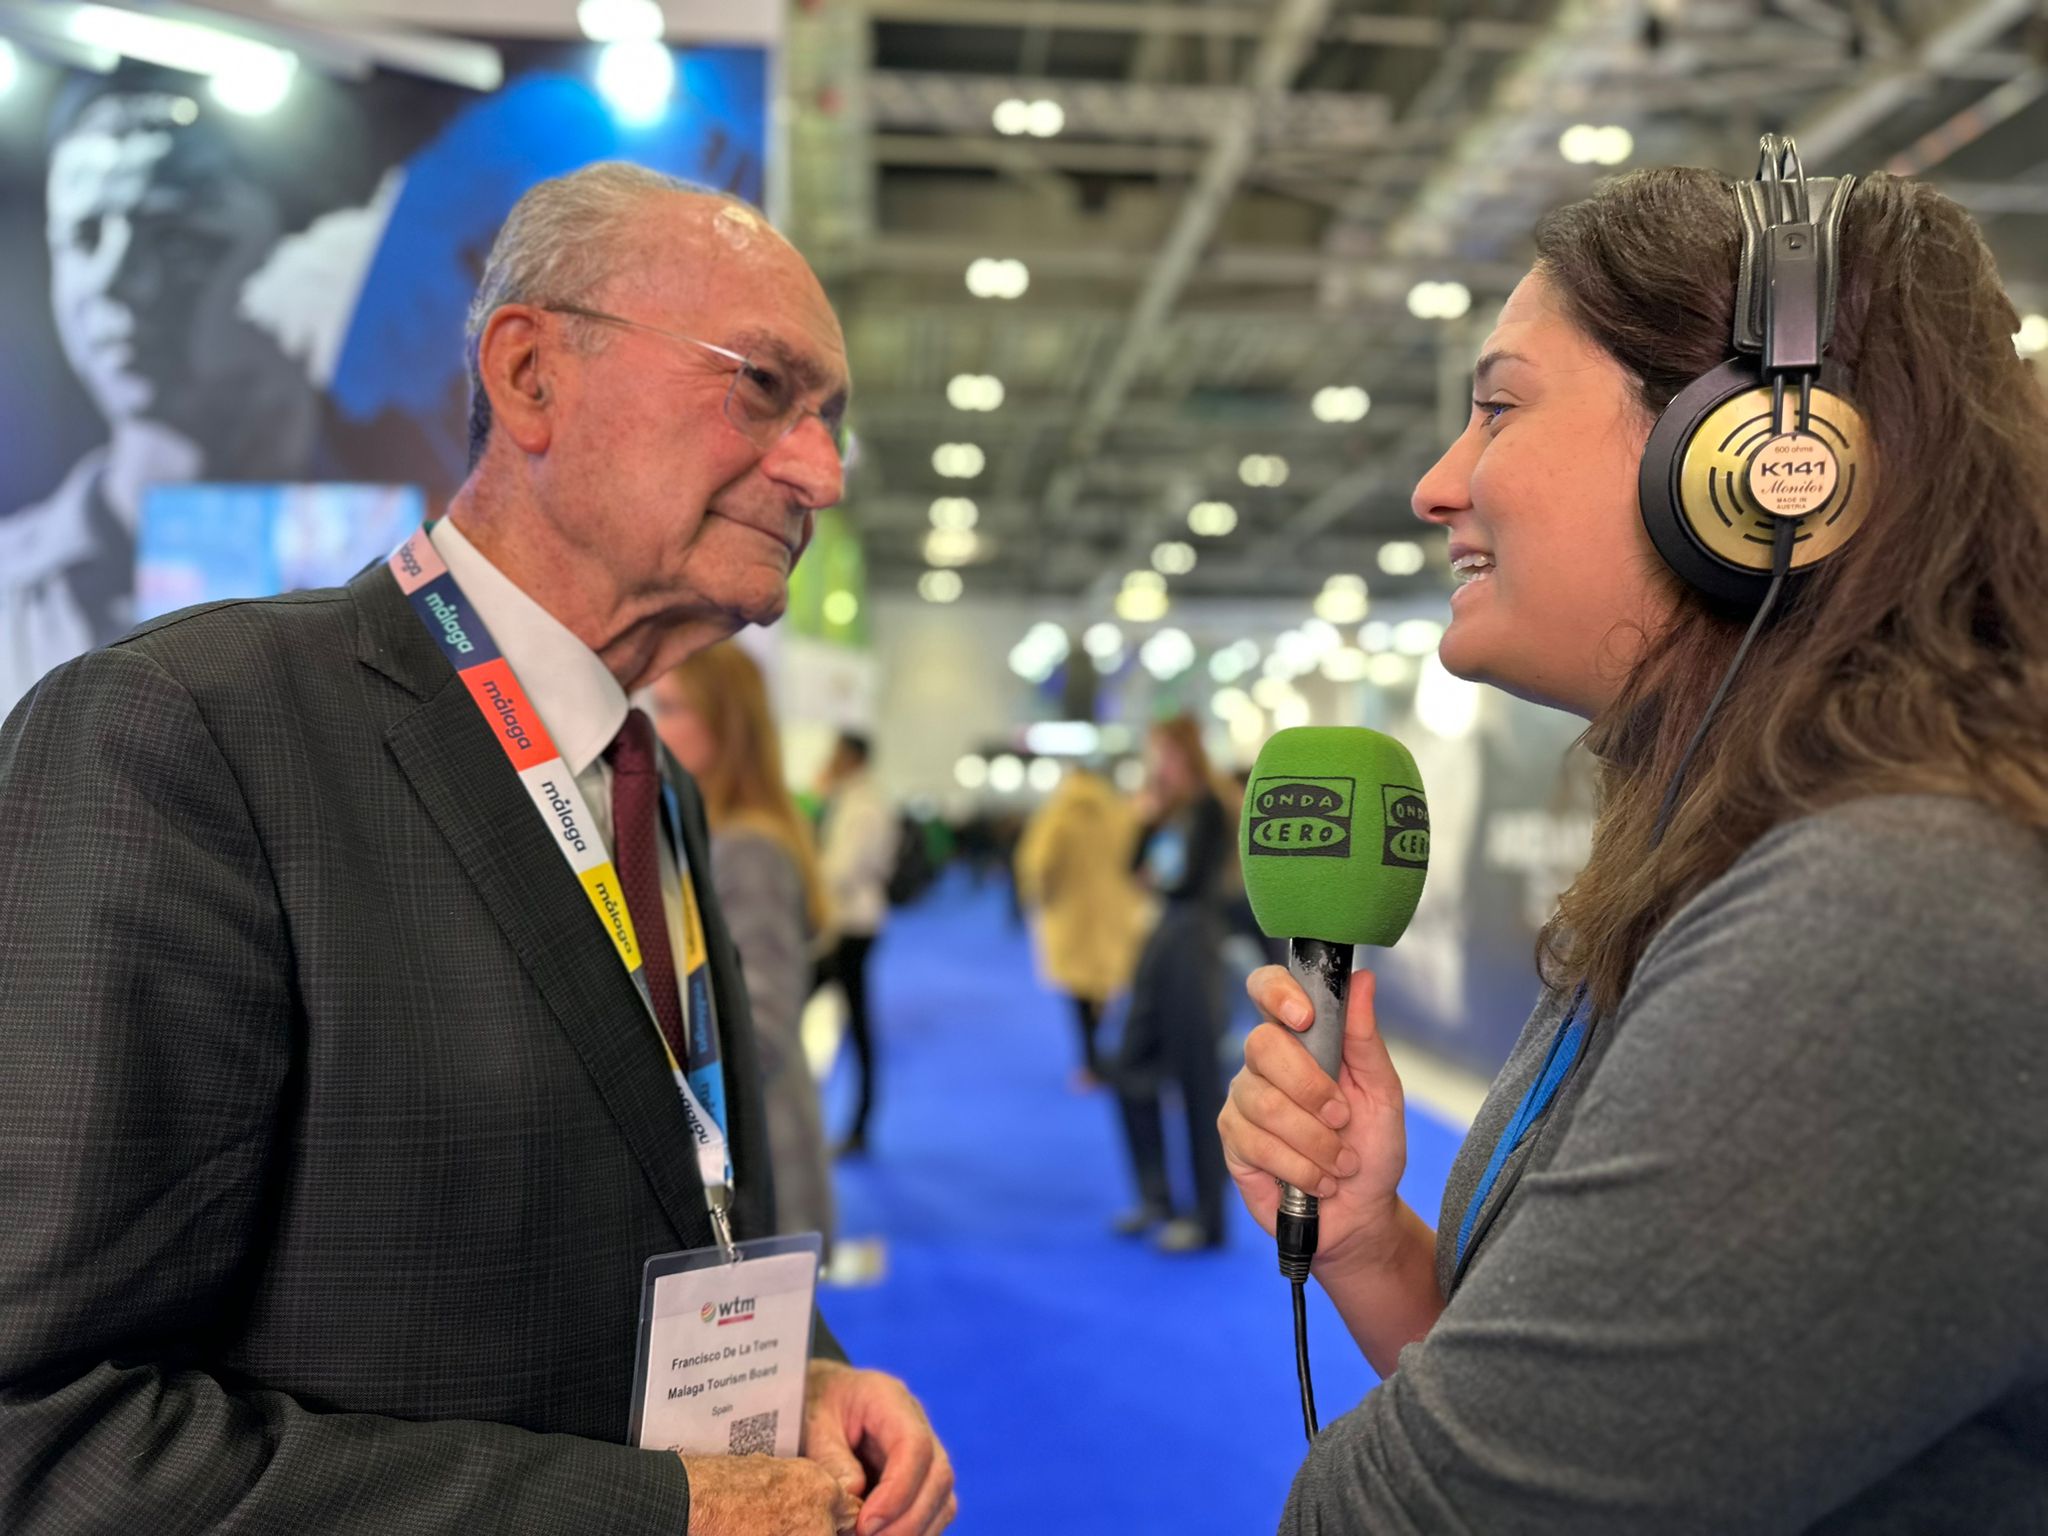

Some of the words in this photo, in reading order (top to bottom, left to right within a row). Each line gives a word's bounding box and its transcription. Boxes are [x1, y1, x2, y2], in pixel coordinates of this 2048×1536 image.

[1761, 461, 1826, 476] K141
[1761, 479, 1823, 494] Monitor
[1262, 793, 1334, 809] ONDA
[1262, 823, 1334, 842] CERO
[719, 1296, 755, 1317] wtm
[671, 1351, 721, 1371] Francisco
[723, 1346, 737, 1359] De
[739, 1344, 751, 1356] La
[753, 1339, 779, 1352] Torre
[667, 1383, 704, 1400] Malaga
[707, 1373, 747, 1390] Tourism
[749, 1364, 778, 1380] Board
[711, 1404, 734, 1417] Spain
